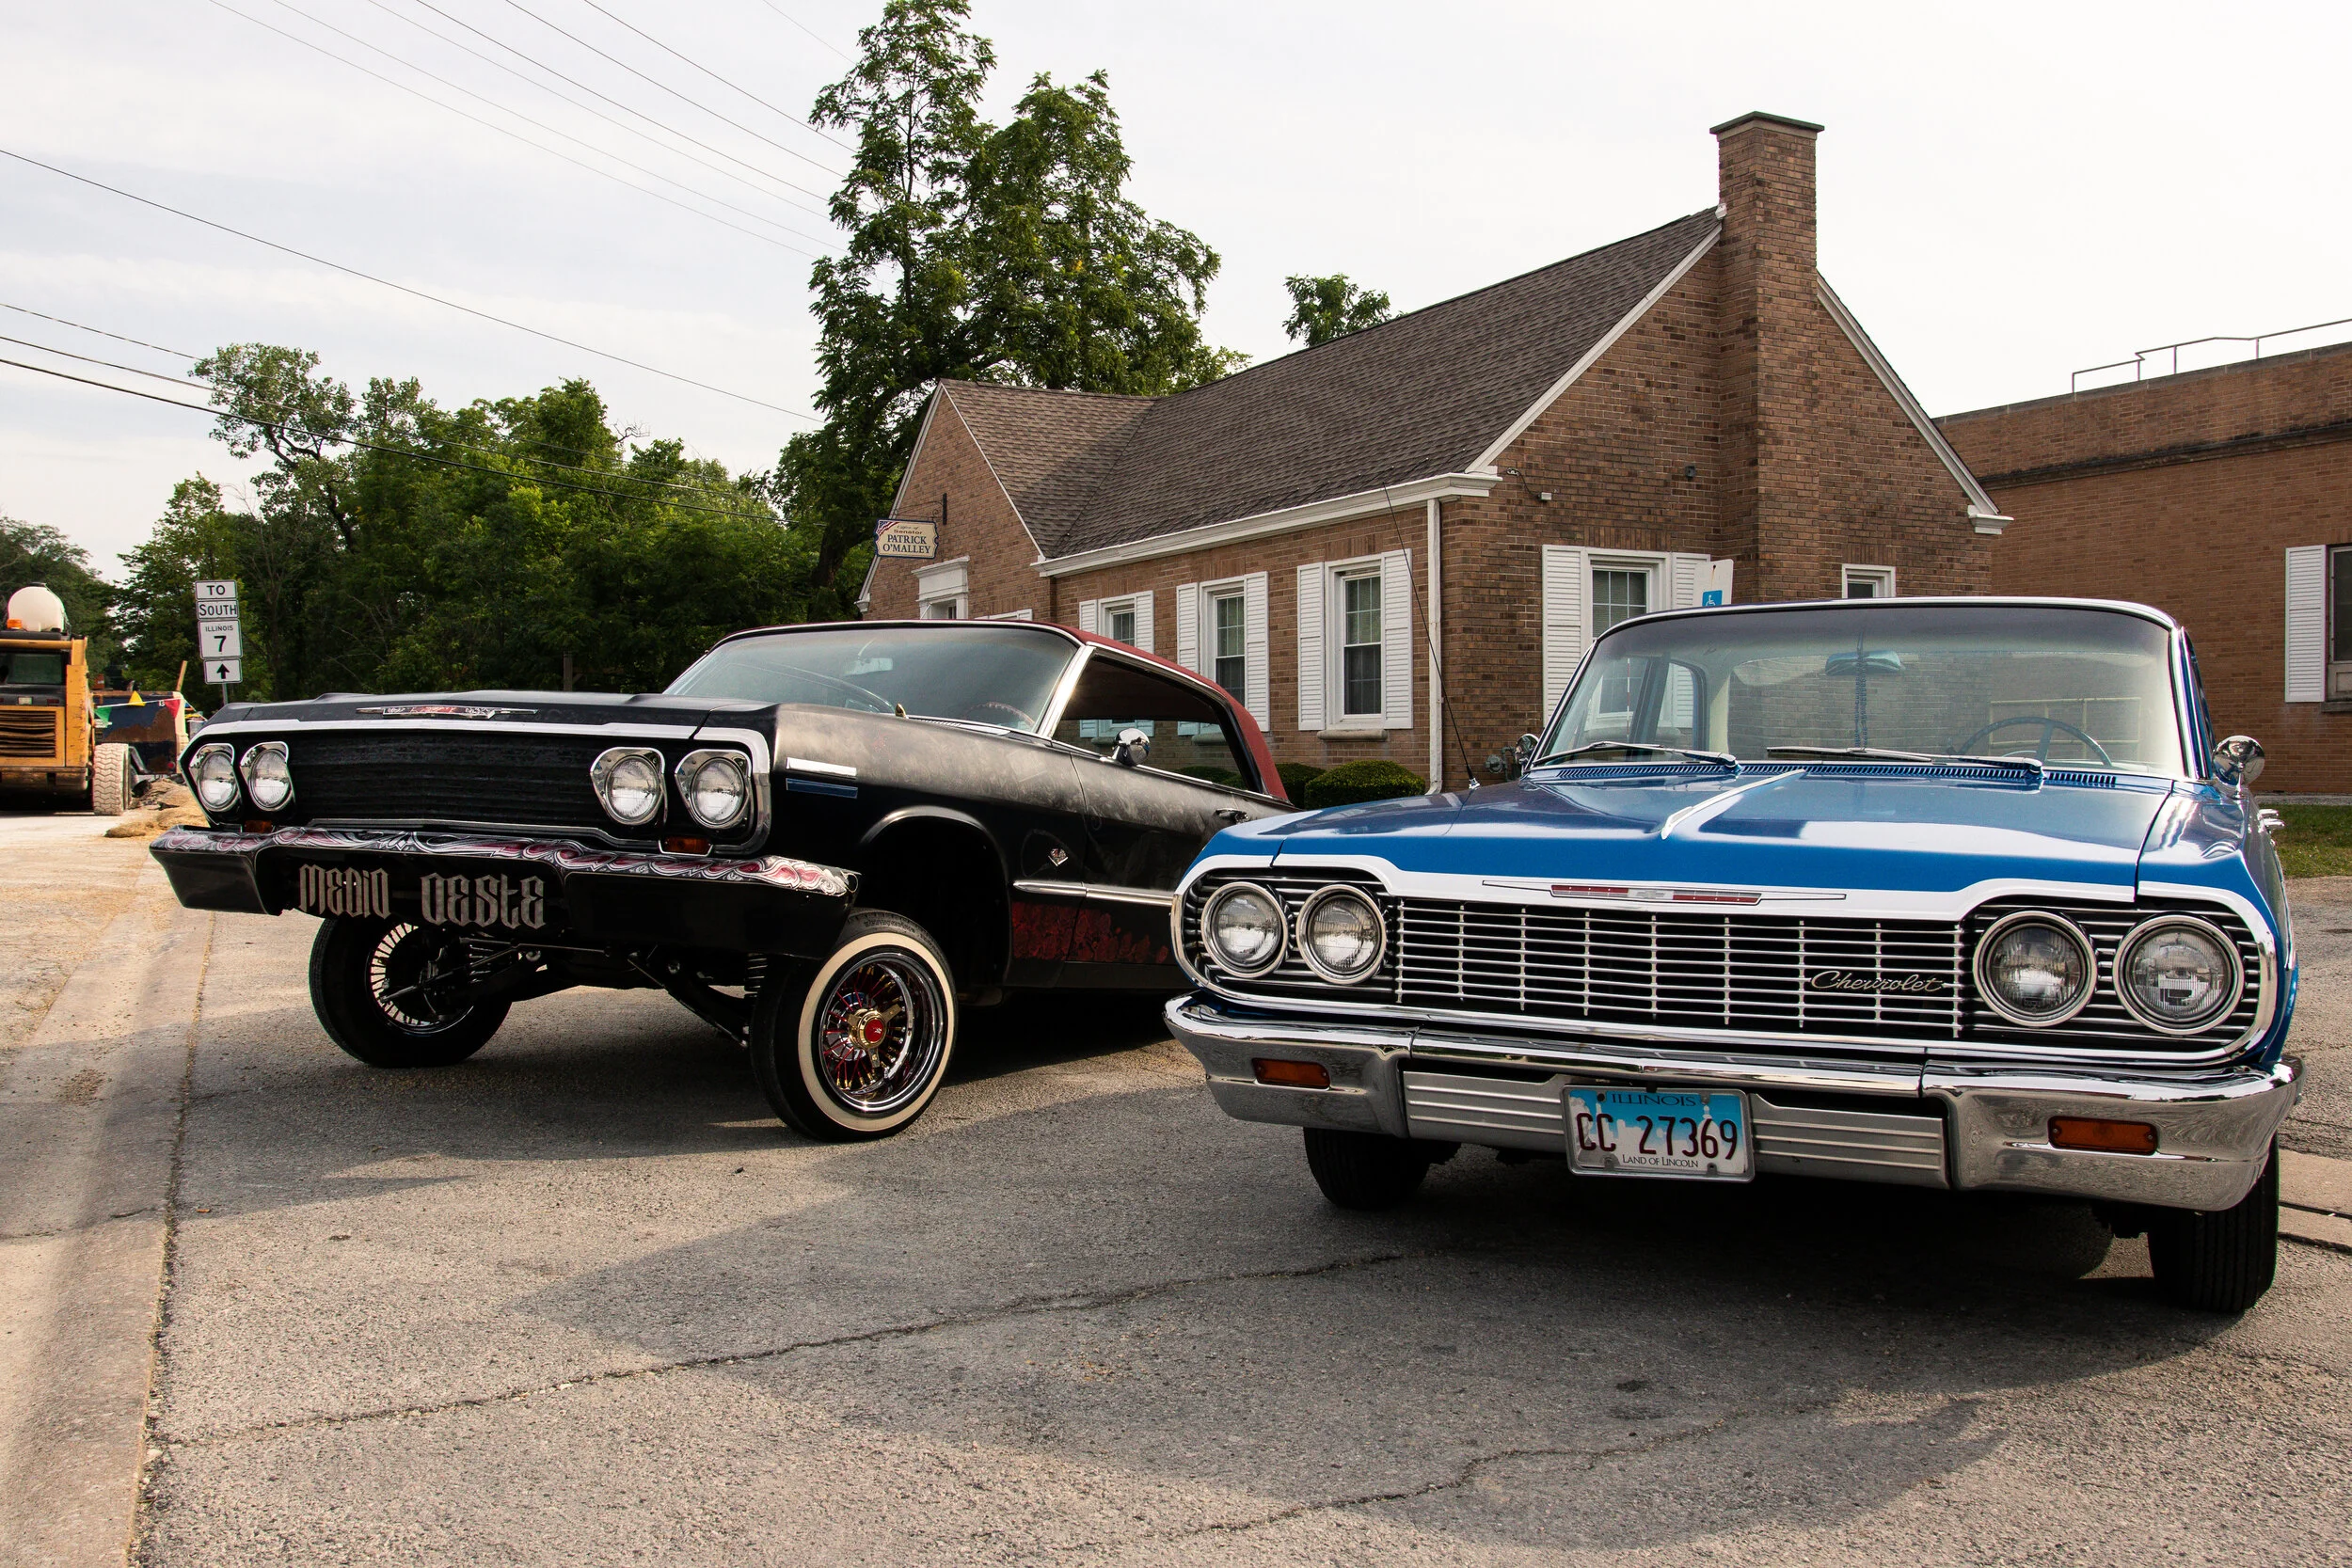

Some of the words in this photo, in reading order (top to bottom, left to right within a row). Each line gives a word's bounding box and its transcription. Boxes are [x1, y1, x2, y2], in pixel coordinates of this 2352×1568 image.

[887, 534, 927, 545] PATRICK
[882, 544, 930, 553] O'MALLEY
[206, 584, 226, 595] TO
[199, 604, 237, 616] SOUTH
[214, 635, 227, 652] 7
[1811, 970, 1944, 992] Chevrolet
[1612, 1094, 1697, 1107] ILLINOIS
[1576, 1113, 1616, 1152] CC
[1636, 1115, 1738, 1161] 27369
